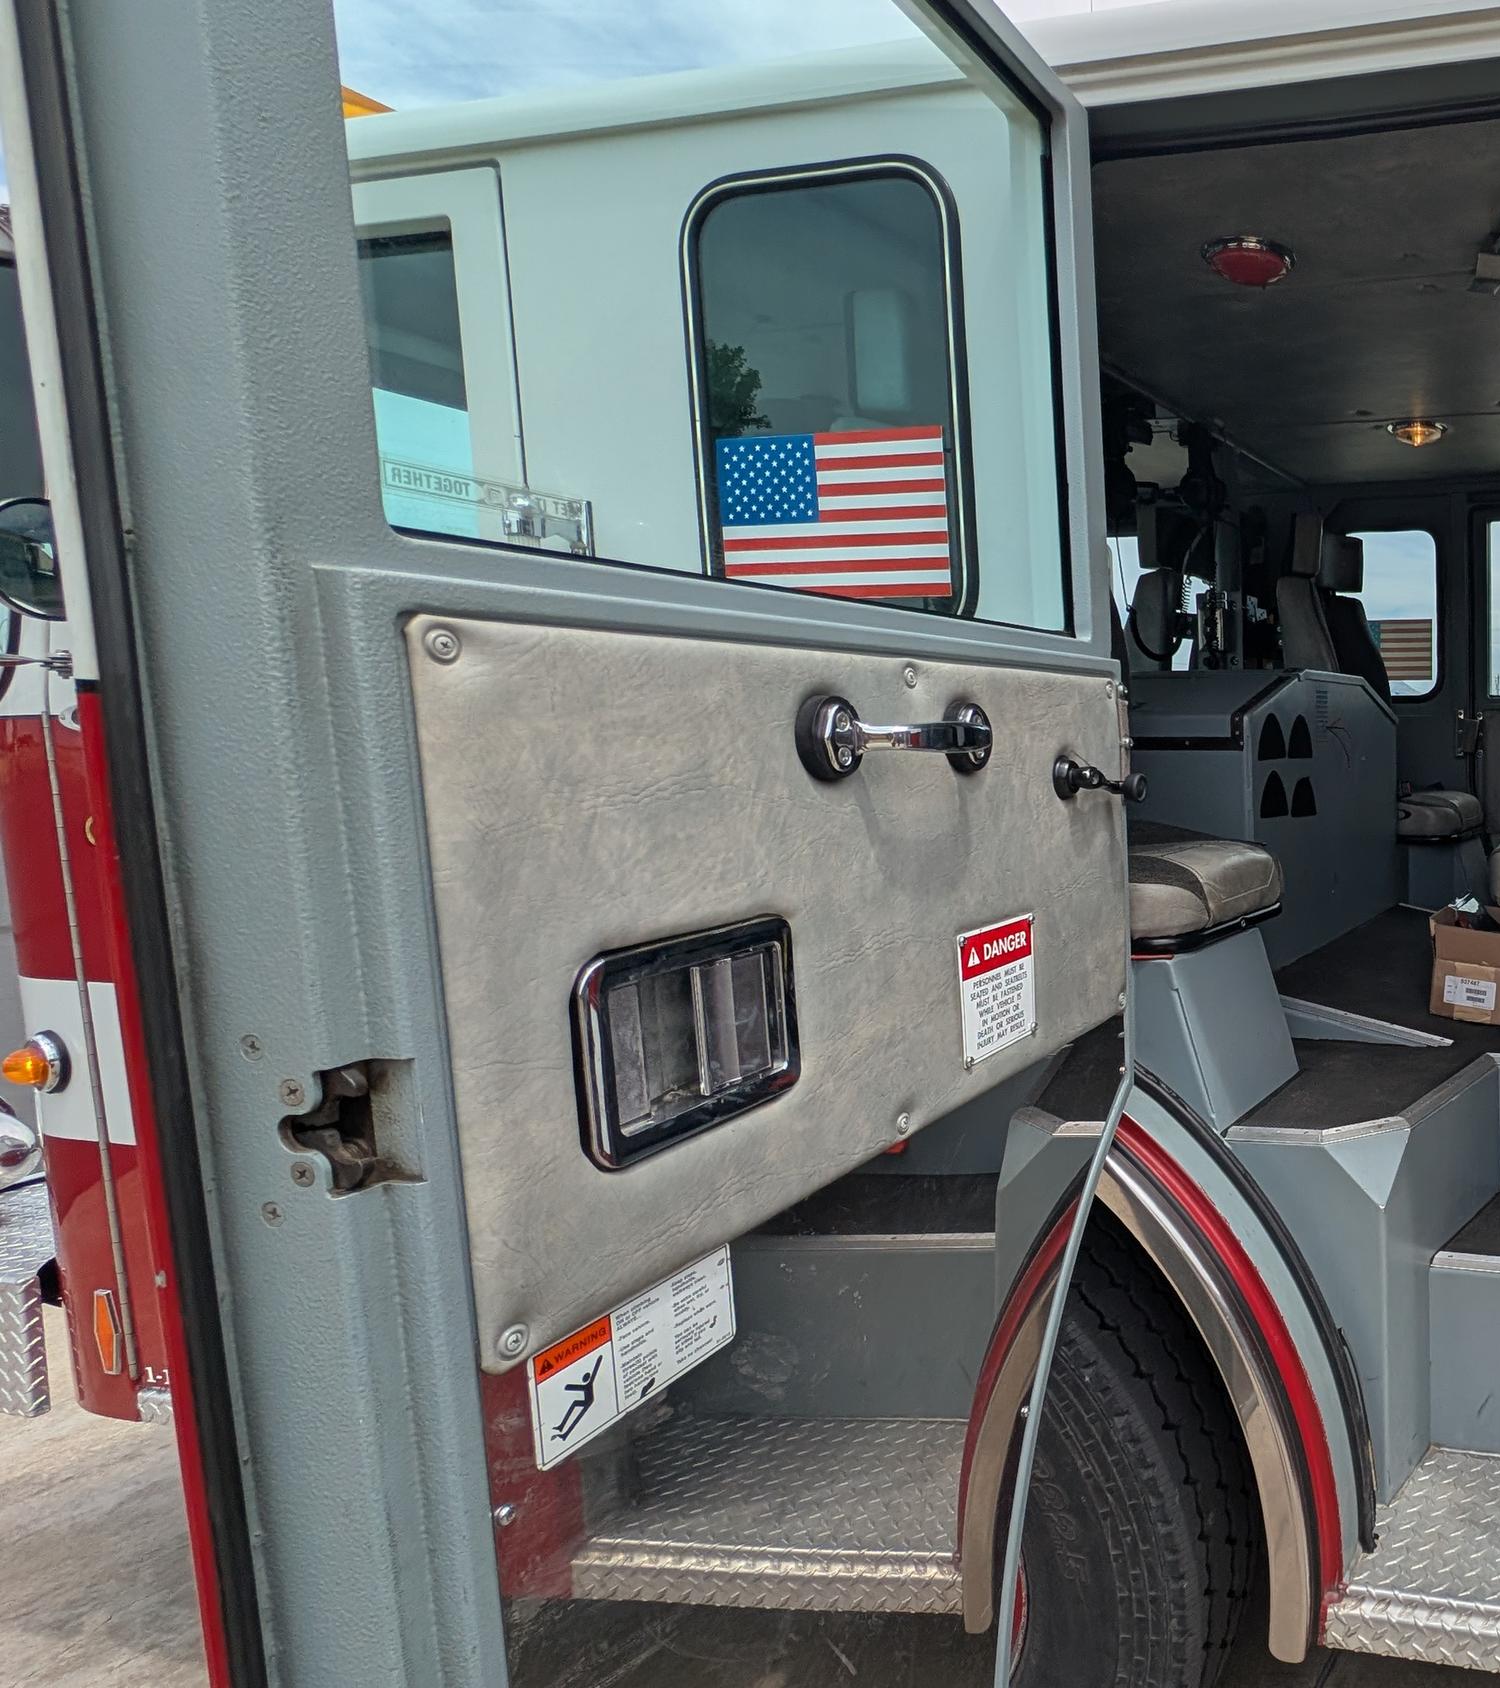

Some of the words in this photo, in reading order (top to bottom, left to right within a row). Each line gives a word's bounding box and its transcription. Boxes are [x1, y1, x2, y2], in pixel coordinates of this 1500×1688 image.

[984, 930, 1026, 960] DANGER
[971, 988, 988, 1001] SEATED
[992, 982, 1002, 992] AND
[973, 972, 1001, 990] PERSONNEL
[1004, 966, 1016, 977] MUST
[976, 998, 989, 1009] MUST
[1001, 982, 1023, 998] FASTENED
[979, 1006, 993, 1018] WHILE
[997, 996, 1014, 1009] VEHICLE
[978, 1026, 993, 1039] DEATH
[996, 1021, 1003, 1030] OR
[1006, 1011, 1024, 1025] SERIOUS
[982, 1019, 987, 1027] IN
[991, 1008, 1010, 1022] MOTION
[1013, 1003, 1019, 1012] OR
[977, 1035, 994, 1049] INJURY
[997, 1029, 1007, 1040] MAY
[1010, 1020, 1025, 1032] RESULT
[553, 1327, 607, 1364] WARNING
